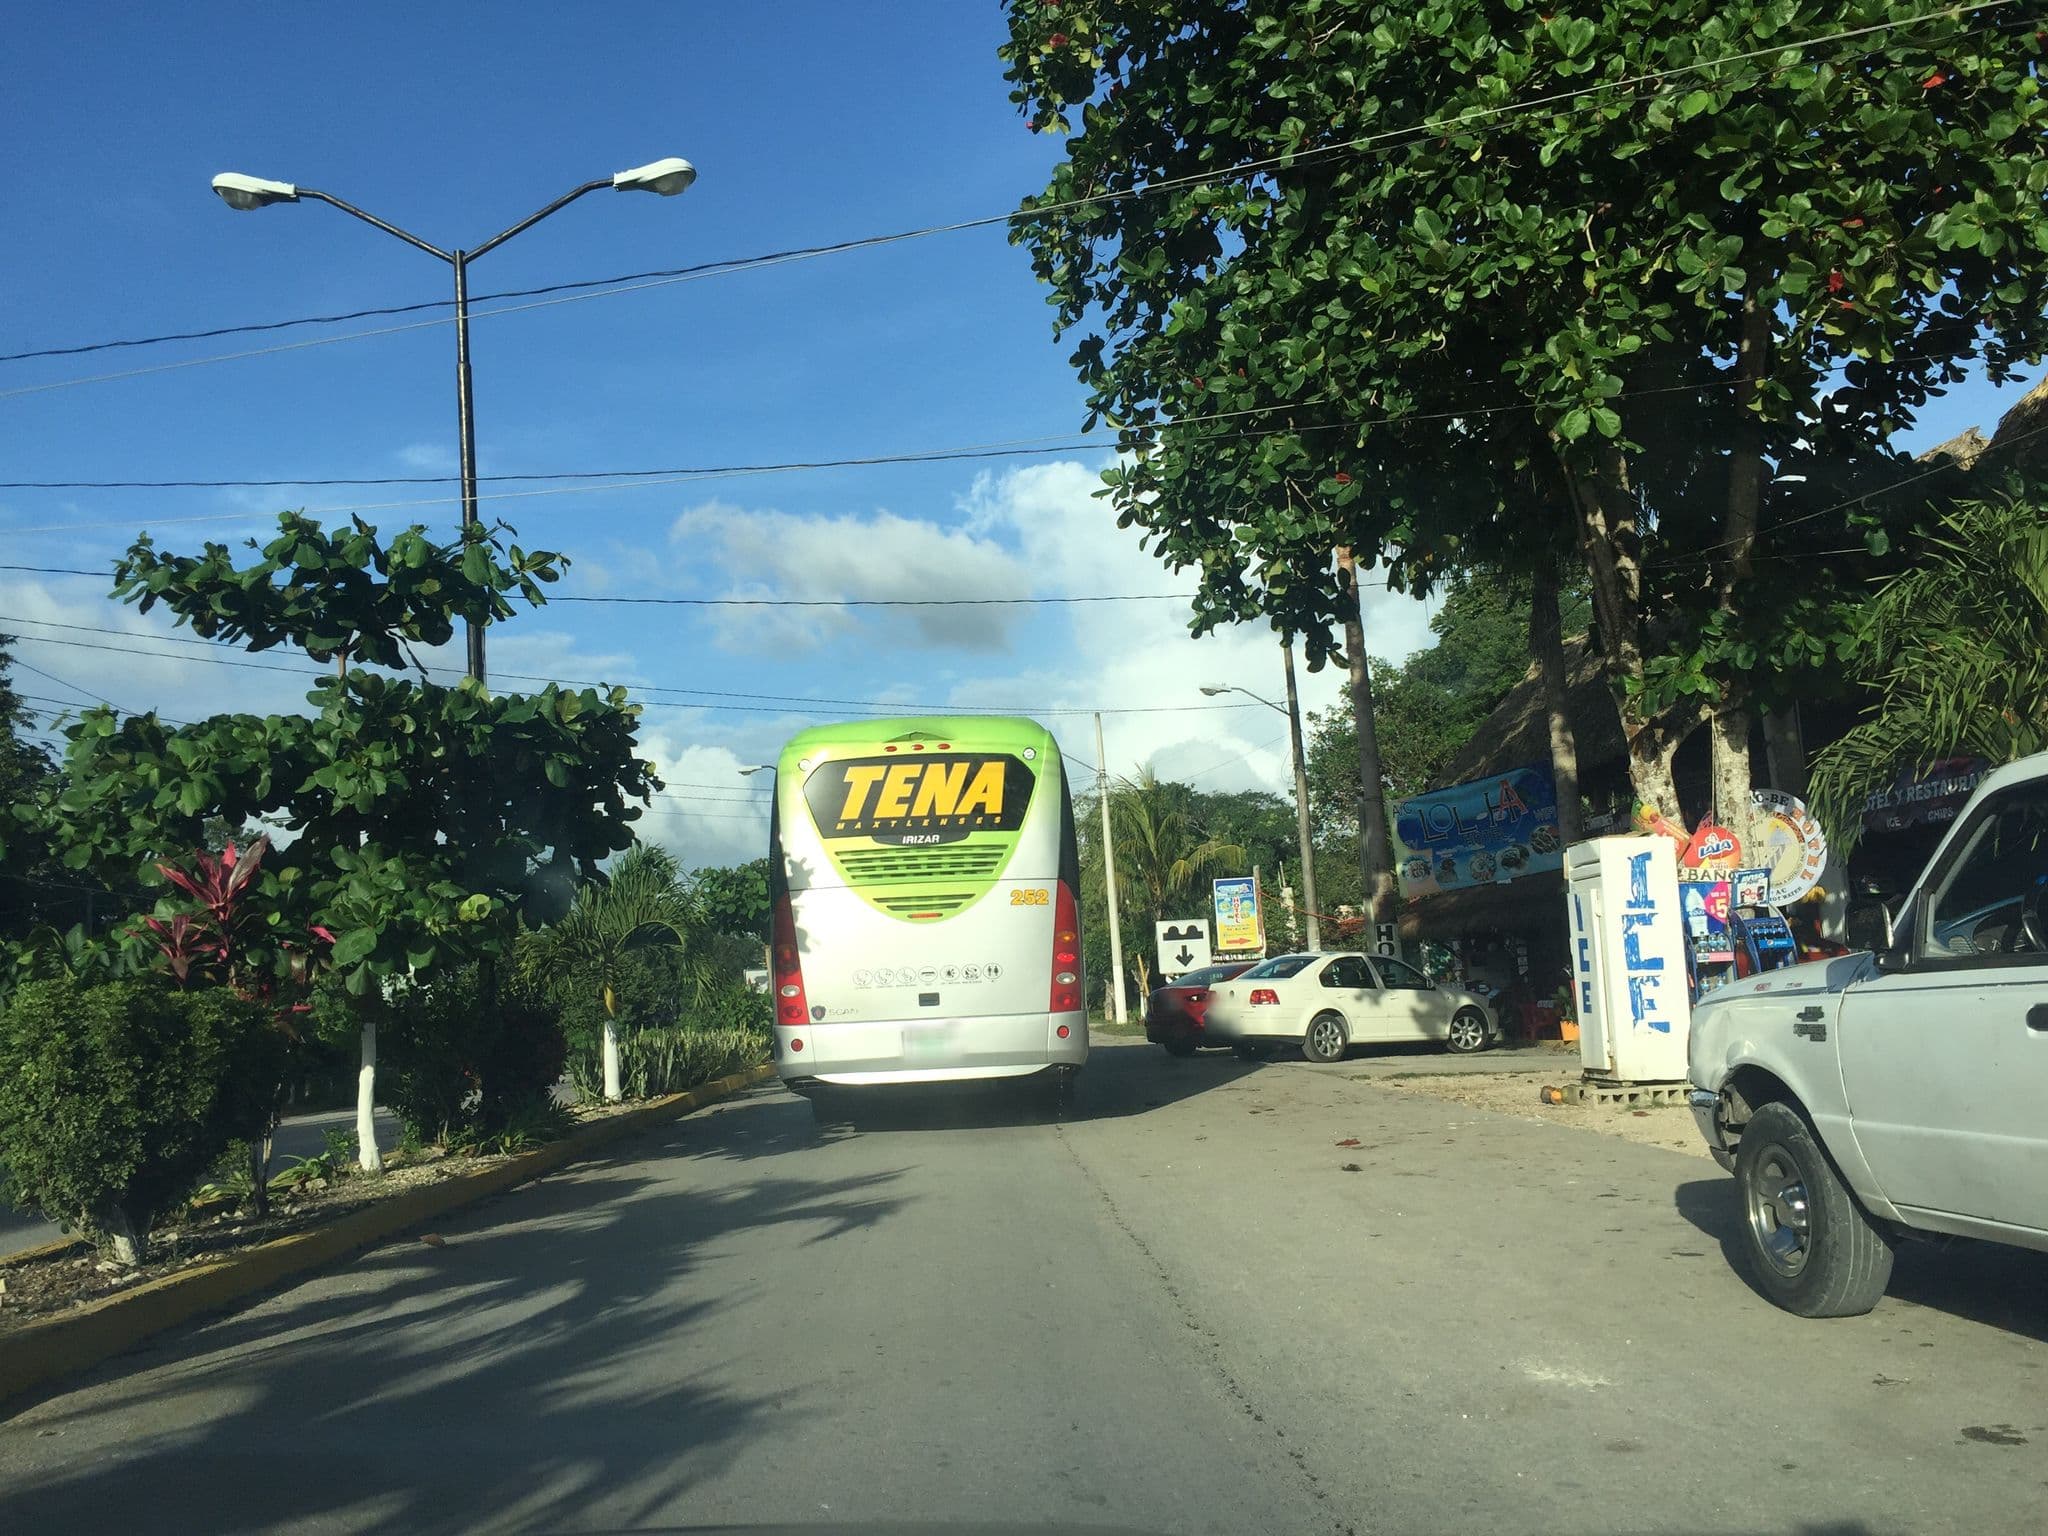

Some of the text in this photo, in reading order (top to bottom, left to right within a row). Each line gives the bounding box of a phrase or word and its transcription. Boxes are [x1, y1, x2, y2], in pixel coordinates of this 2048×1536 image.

[840, 761, 1005, 820] TENA
[1887, 817, 1901, 827] ICE
[1927, 807, 1954, 821] CHIPS
[902, 834, 940, 845] IRIZAR
[1699, 839, 1732, 857] LALA
[1792, 807, 1820, 880] HOTEL
[1010, 889, 1049, 905] 252
[1574, 894, 1592, 1013] ICE
